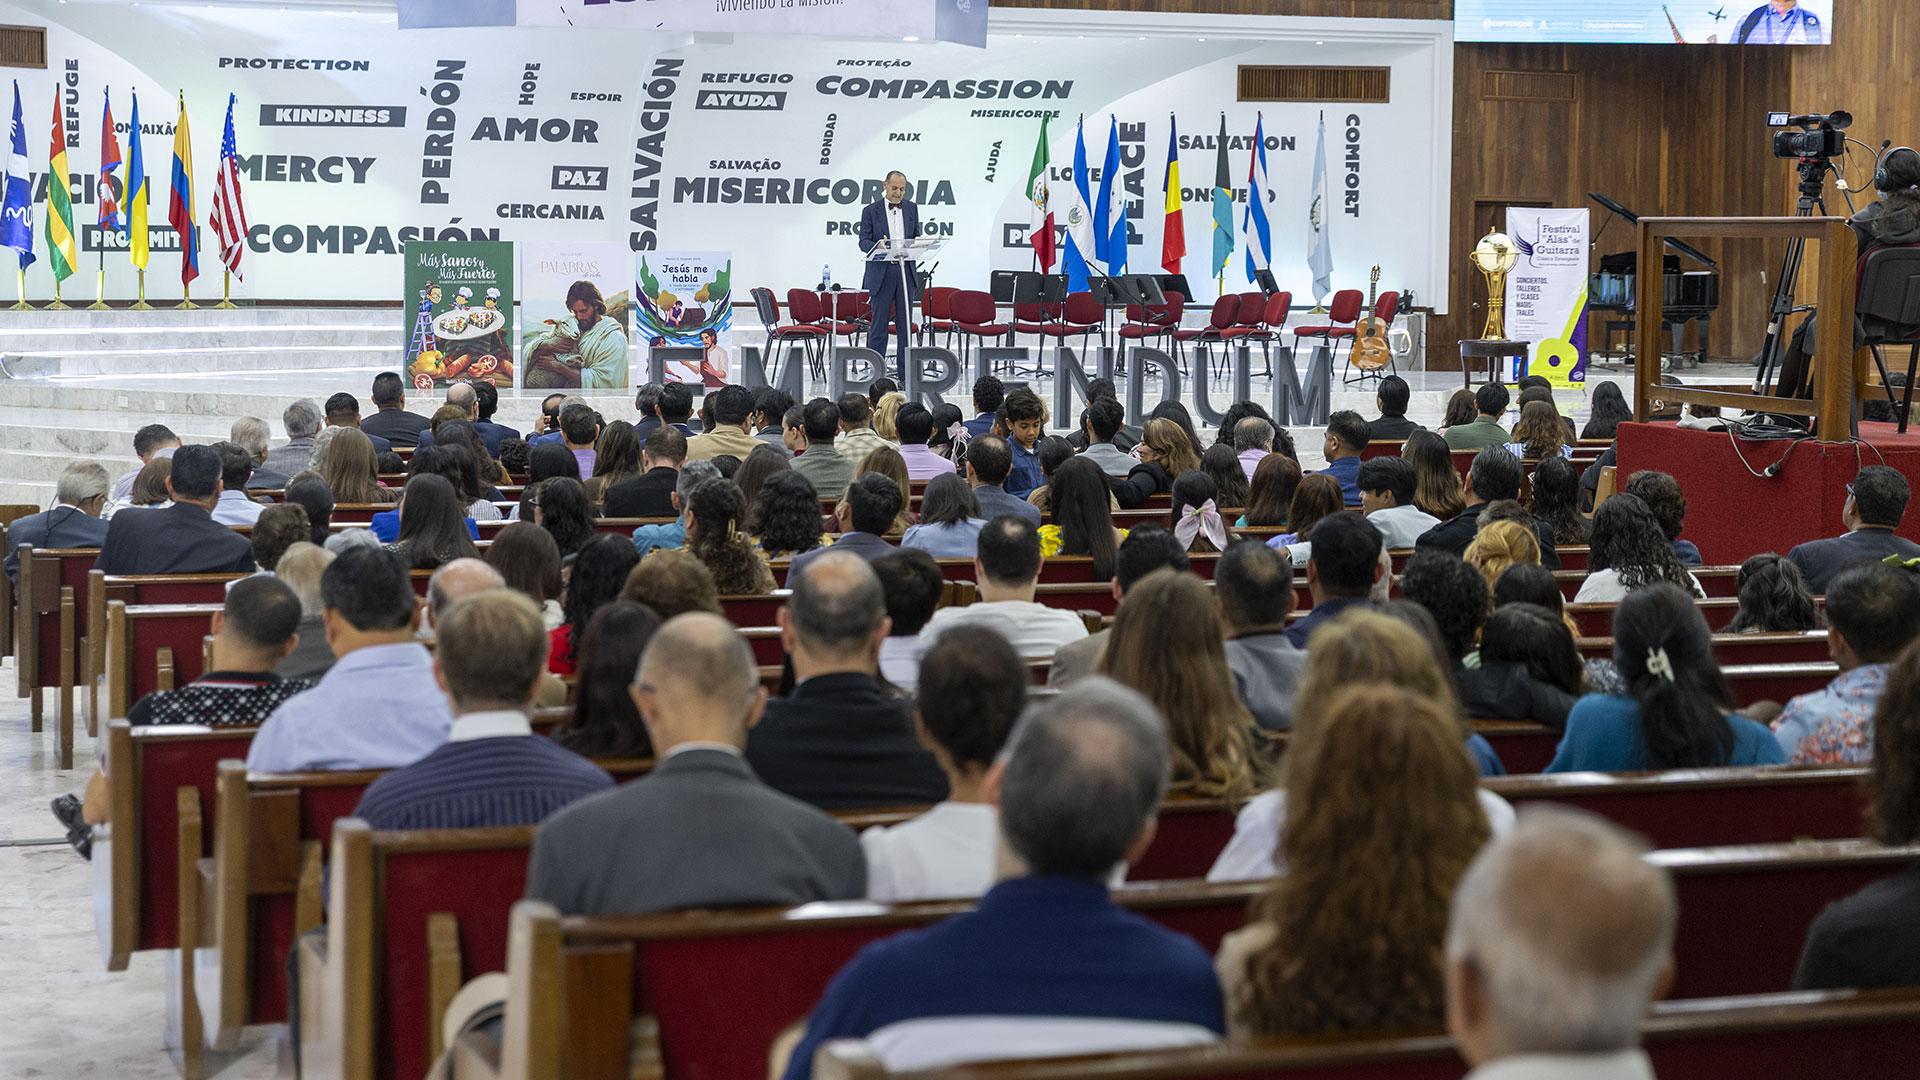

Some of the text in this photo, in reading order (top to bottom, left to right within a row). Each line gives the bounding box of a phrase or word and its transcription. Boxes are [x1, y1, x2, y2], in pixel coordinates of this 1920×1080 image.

[218, 57, 370, 72] PROTECTION
[836, 58, 912, 69] PROTEÇÃO
[518, 62, 541, 106] HOPE
[700, 72, 794, 84] REFUGIO
[815, 74, 1075, 100] COMPASSION
[65, 58, 80, 149] REFUGE
[570, 91, 623, 102] ESPOIR
[702, 93, 778, 107] AYUDA
[275, 107, 390, 124] KINDNESS
[419, 59, 467, 204] PERDÓN
[470, 116, 600, 144] AMOR
[888, 132, 922, 142] PAIX
[819, 112, 838, 166] BONDAD
[629, 58, 685, 252] SALVACIÓN
[985, 140, 1003, 183] AJUDA
[236, 154, 377, 184] MERCY
[709, 157, 782, 172] SALVAÇÃO
[1344, 113, 1361, 218] COMFORT
[558, 170, 602, 187] PAZ
[1119, 121, 1146, 245] PEACE
[496, 203, 605, 220] CERCANIA
[1542, 224, 1581, 234] Festival
[1536, 245, 1580, 255] Guitarra
[417, 252, 440, 269] Más
[440, 252, 479, 268] Sanos
[541, 261, 599, 276] PALABRAS
[662, 263, 690, 273] Jesús
[439, 267, 497, 280] Más Fuertes
[672, 274, 699, 283] habla
